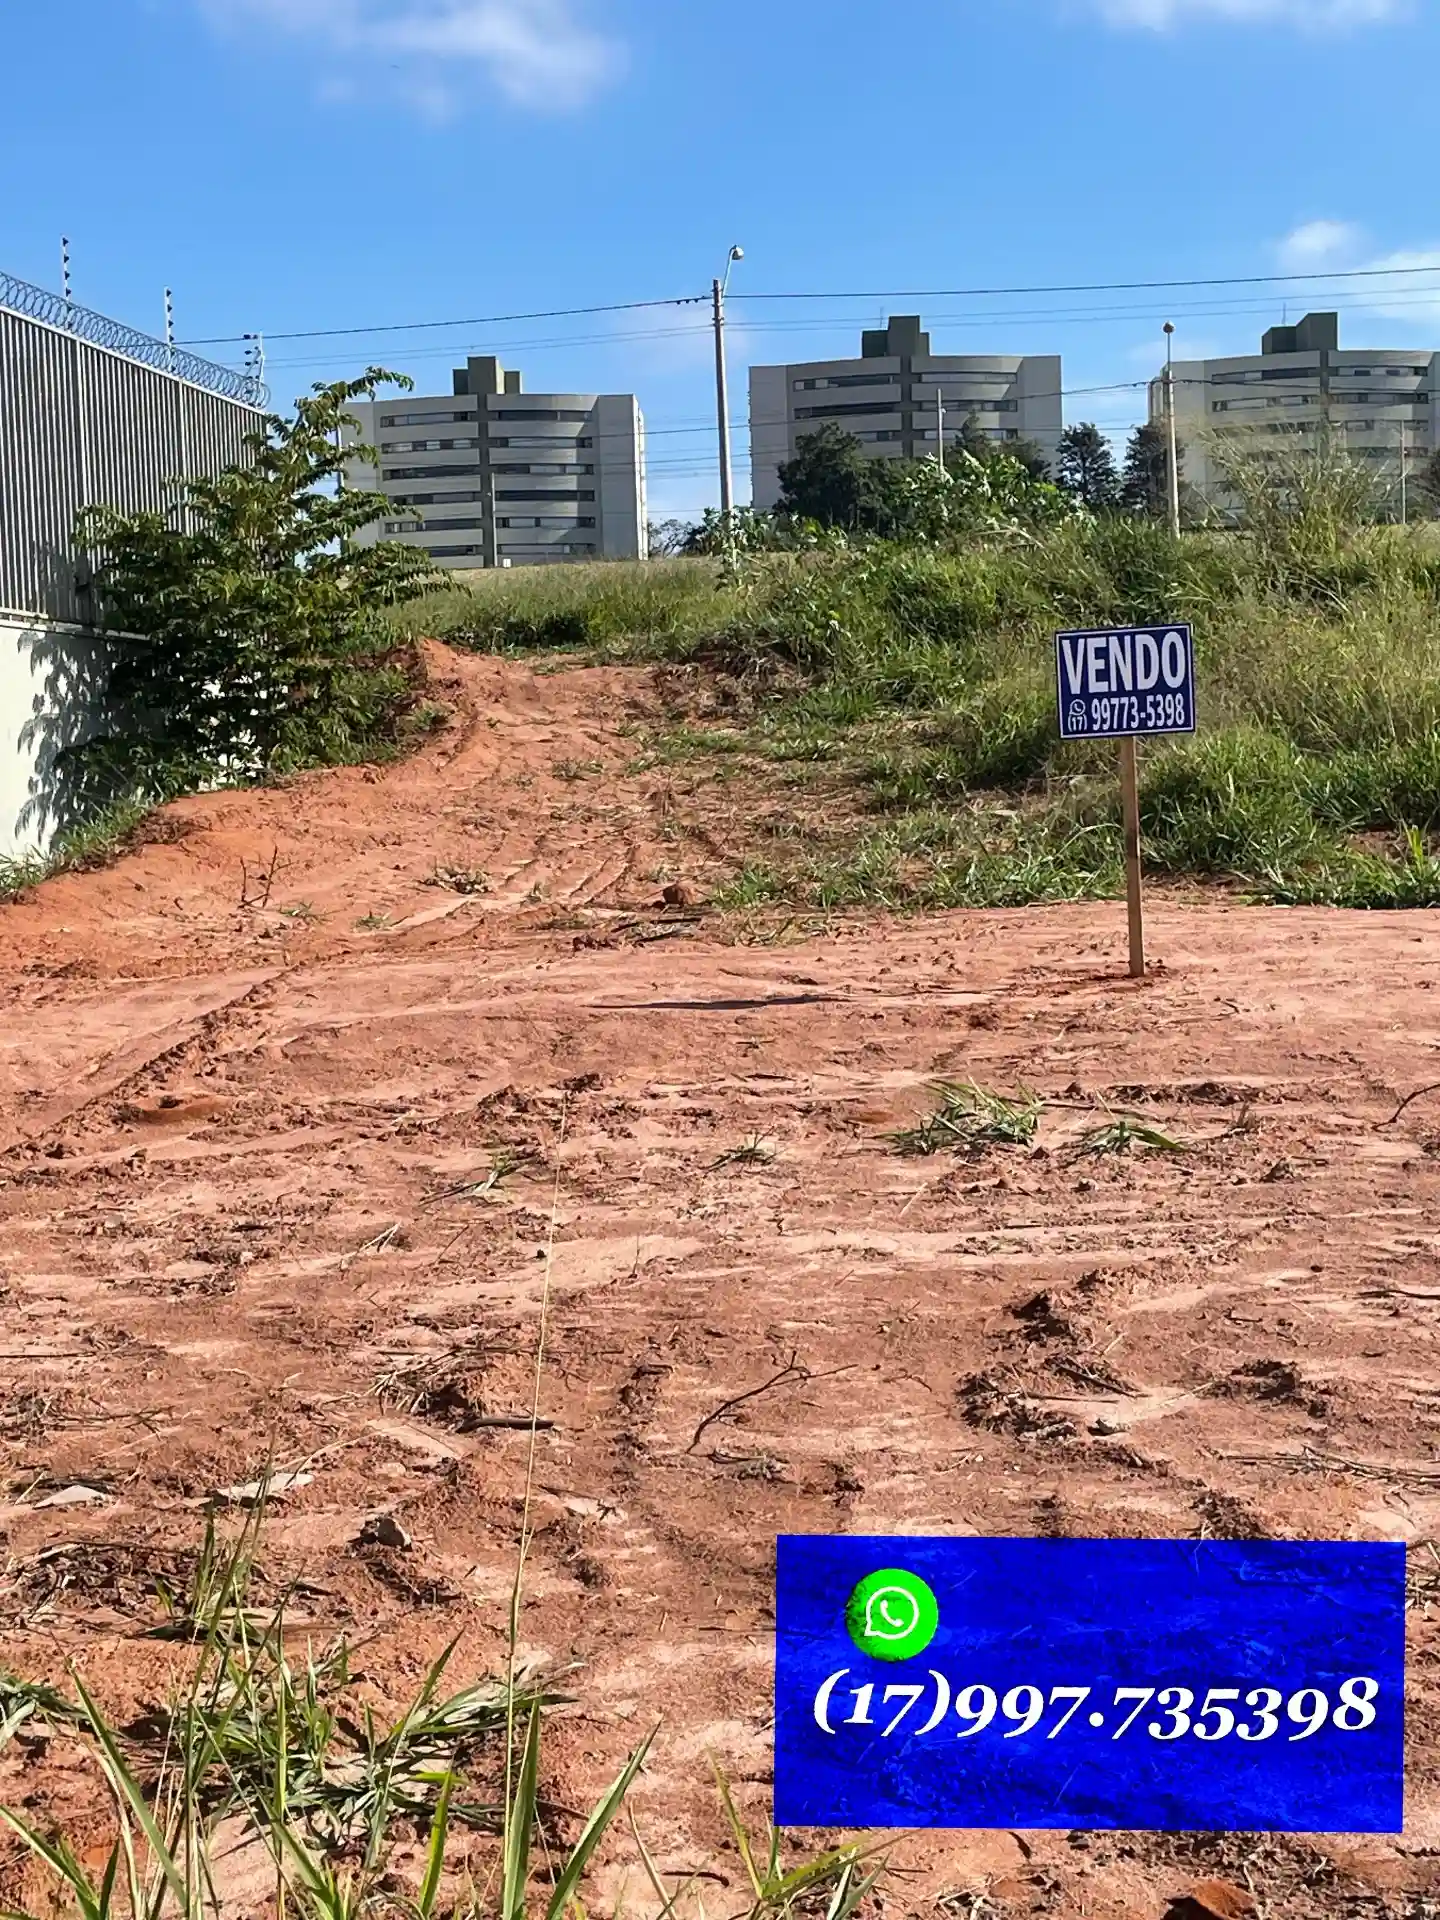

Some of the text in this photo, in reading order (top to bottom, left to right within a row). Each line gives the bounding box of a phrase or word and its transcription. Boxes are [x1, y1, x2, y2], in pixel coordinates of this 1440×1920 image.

[1061, 631, 1186, 695] VENDO
[1068, 693, 1185, 732] (17) 99773-5398
